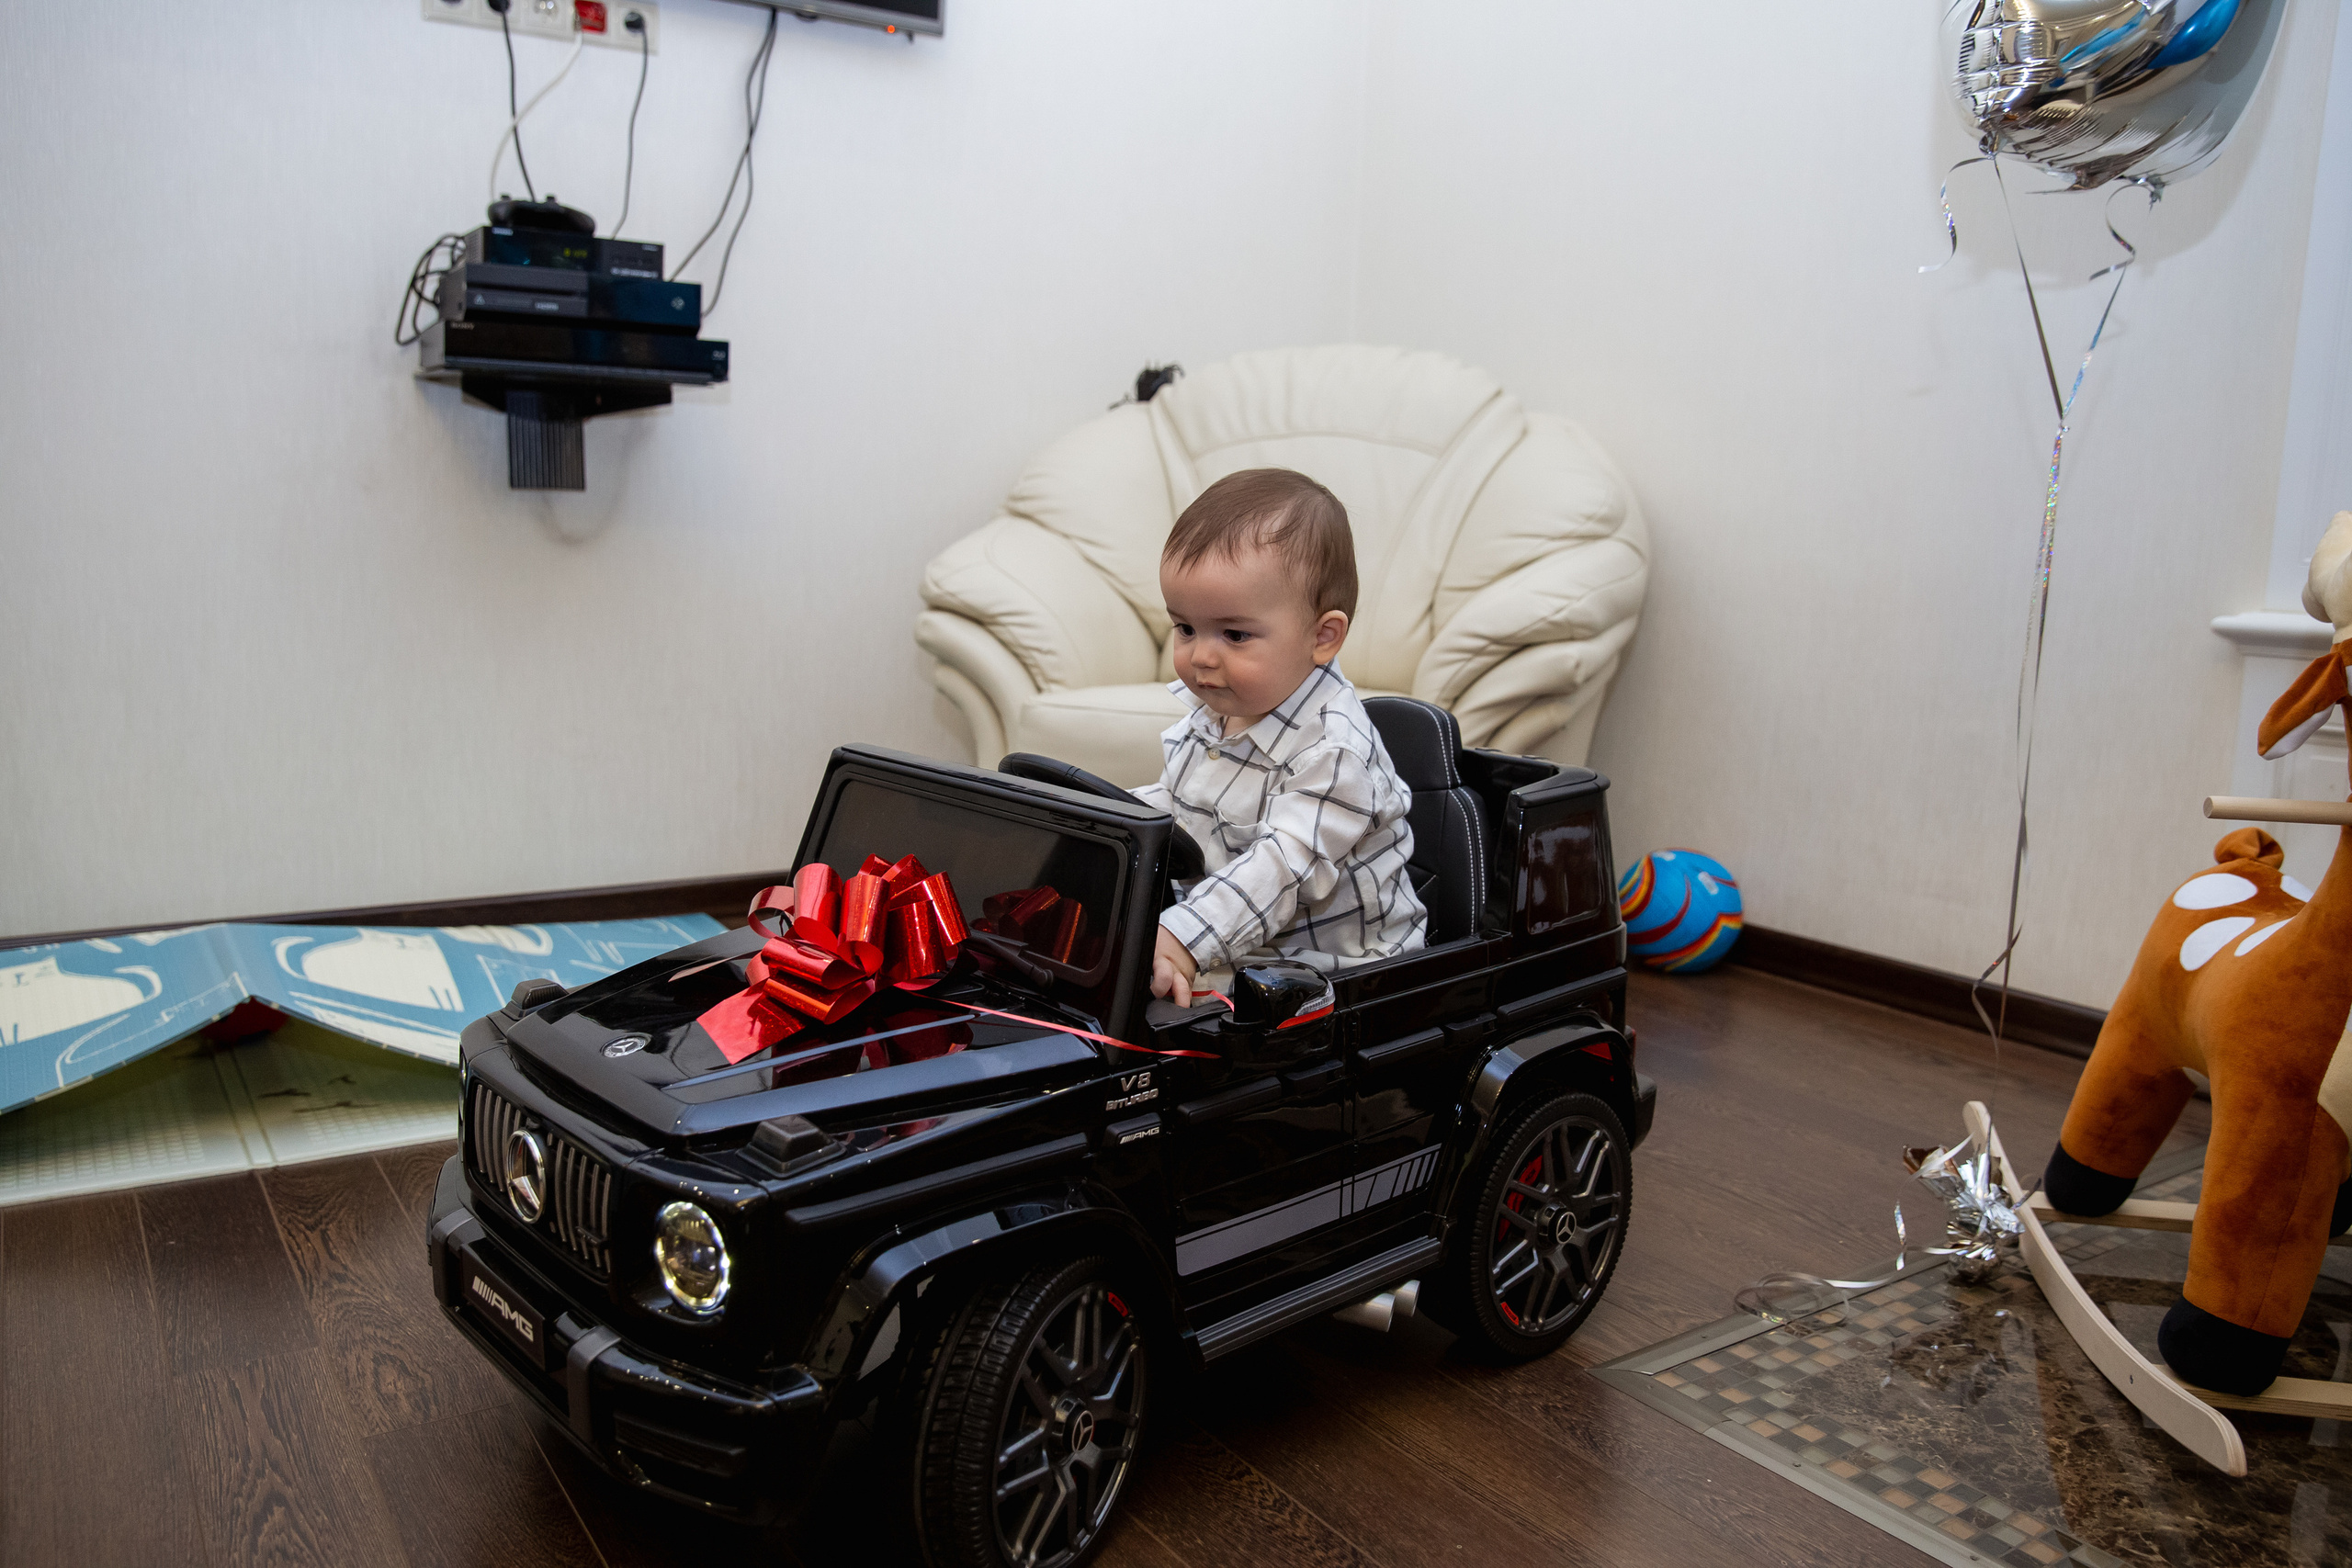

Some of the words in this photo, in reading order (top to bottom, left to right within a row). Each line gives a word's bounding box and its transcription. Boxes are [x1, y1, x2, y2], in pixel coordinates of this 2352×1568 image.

[1121, 1071, 1151, 1092] V8
[1105, 1089, 1159, 1111] BITURBO
[1132, 1126, 1160, 1141] AMG
[490, 1292, 534, 1342] AMG
